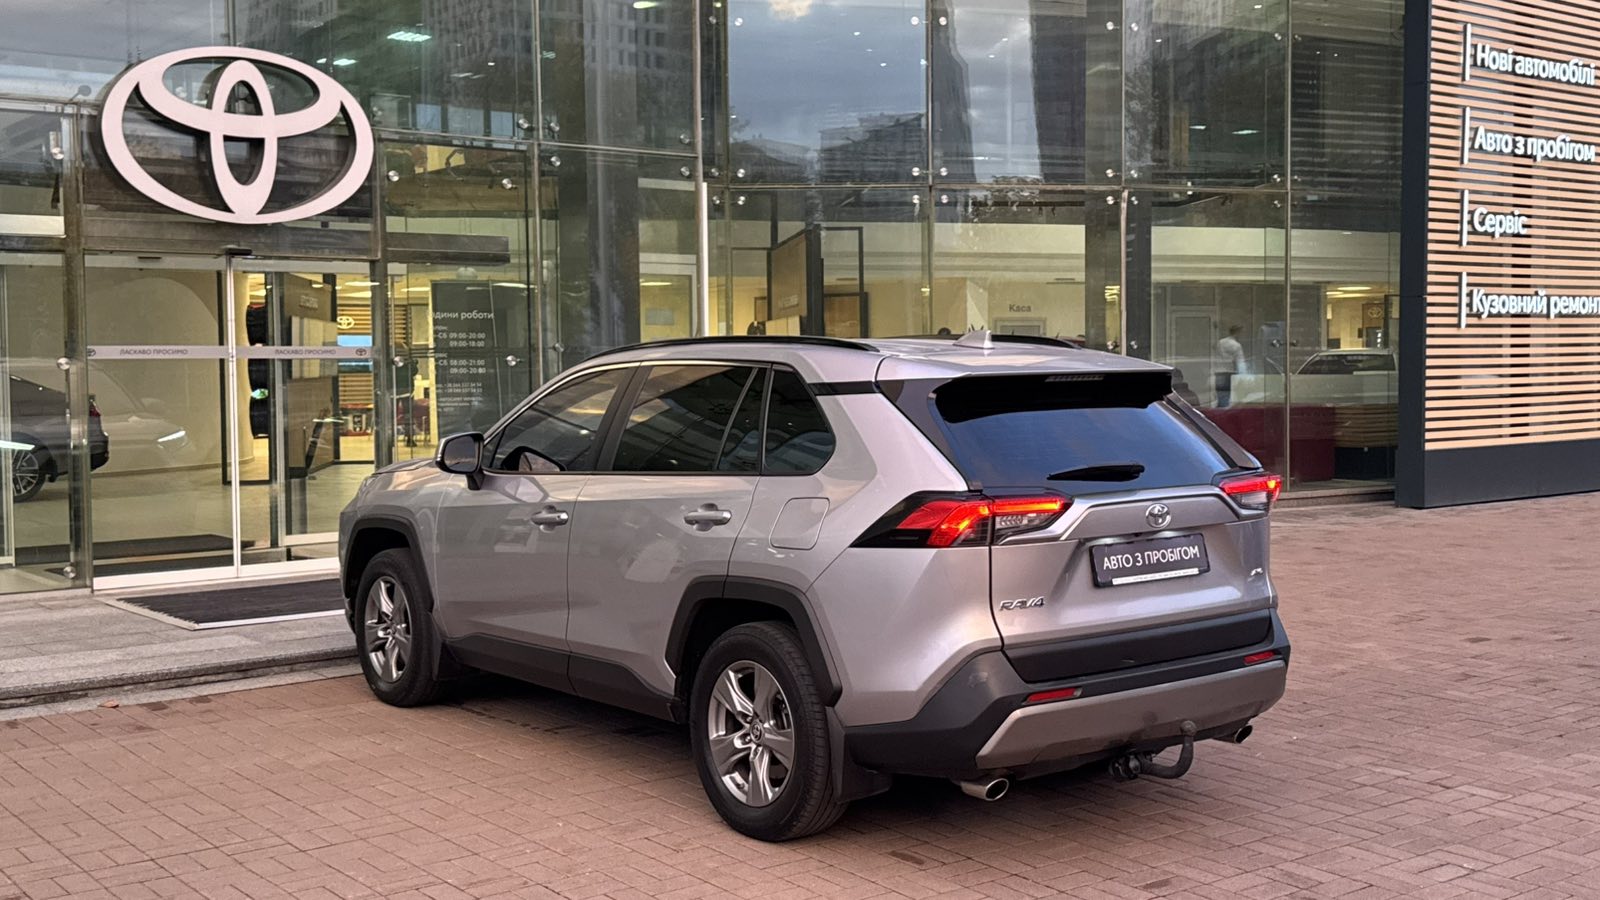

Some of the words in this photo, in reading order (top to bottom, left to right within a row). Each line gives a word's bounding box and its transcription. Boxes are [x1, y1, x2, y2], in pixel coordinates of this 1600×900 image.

[1476, 43, 1514, 72] Нові
[1515, 58, 1596, 86] автомобілі
[1474, 125, 1513, 153] Авто
[1514, 136, 1525, 155] з
[1526, 134, 1596, 162] пробігом
[1473, 206, 1528, 239] Сервіс
[432, 311, 459, 320] дини
[460, 310, 495, 321] роботи
[1008, 303, 1032, 313] Каса
[1472, 288, 1548, 319] Кузовний
[1102, 553, 1133, 571] АВТО
[1144, 545, 1200, 565] ПРОБІГОМ
[999, 595, 1046, 611] RAV4
